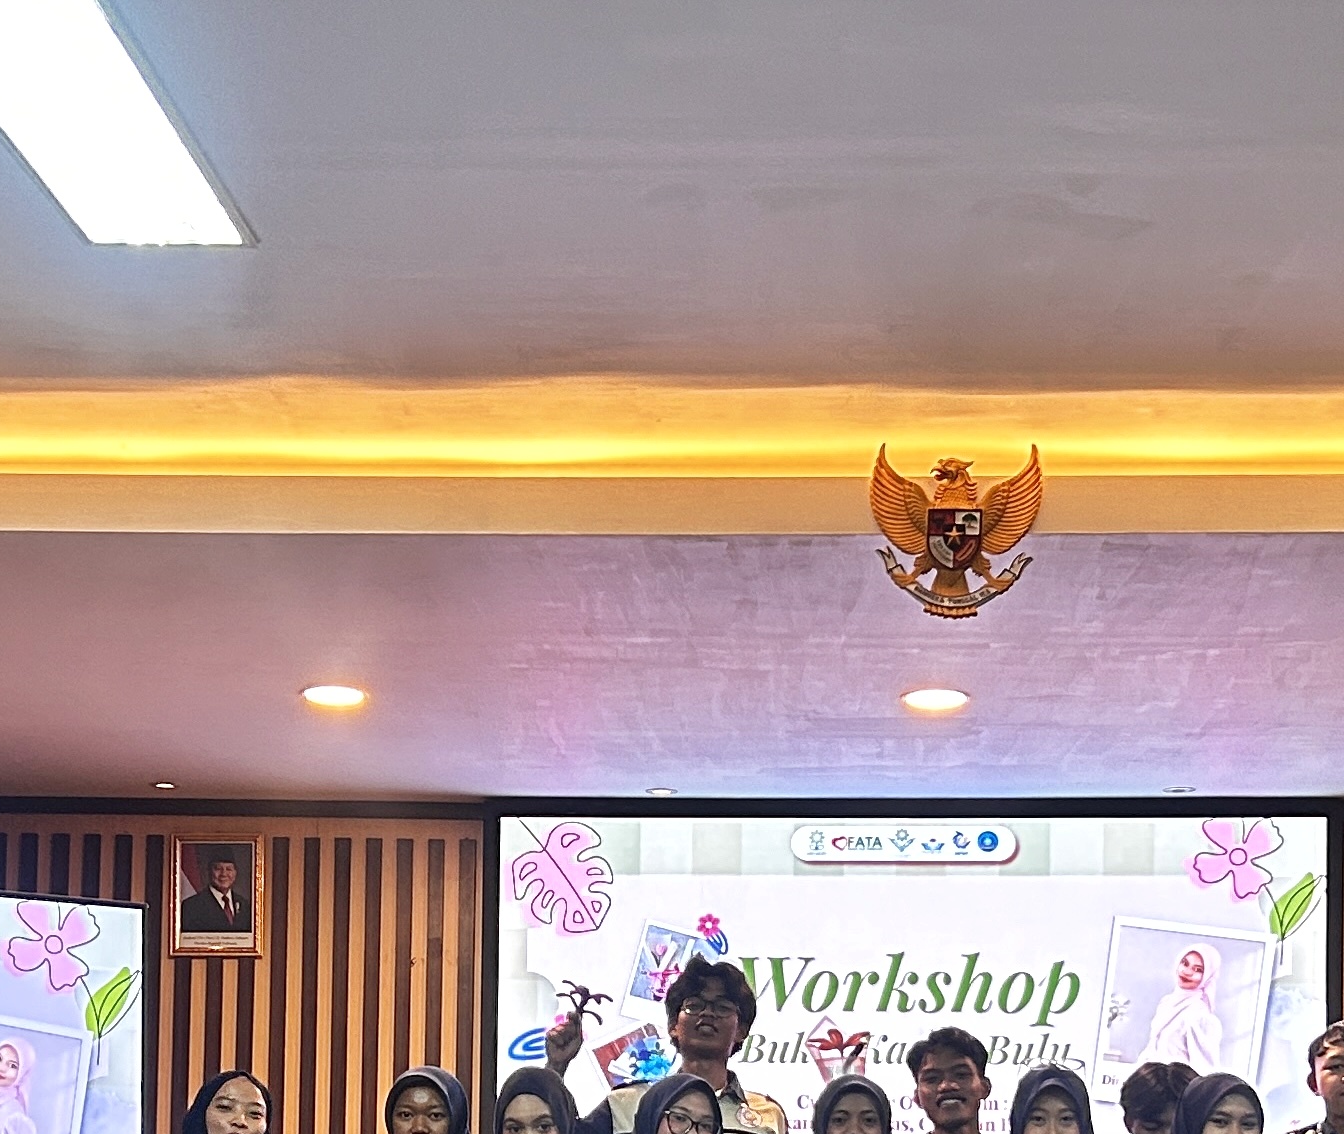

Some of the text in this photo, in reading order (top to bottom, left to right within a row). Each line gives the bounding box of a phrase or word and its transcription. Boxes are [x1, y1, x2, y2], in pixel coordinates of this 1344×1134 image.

[738, 952, 1080, 1027] Workshop
[738, 1031, 1071, 1066] Buk Bulu
